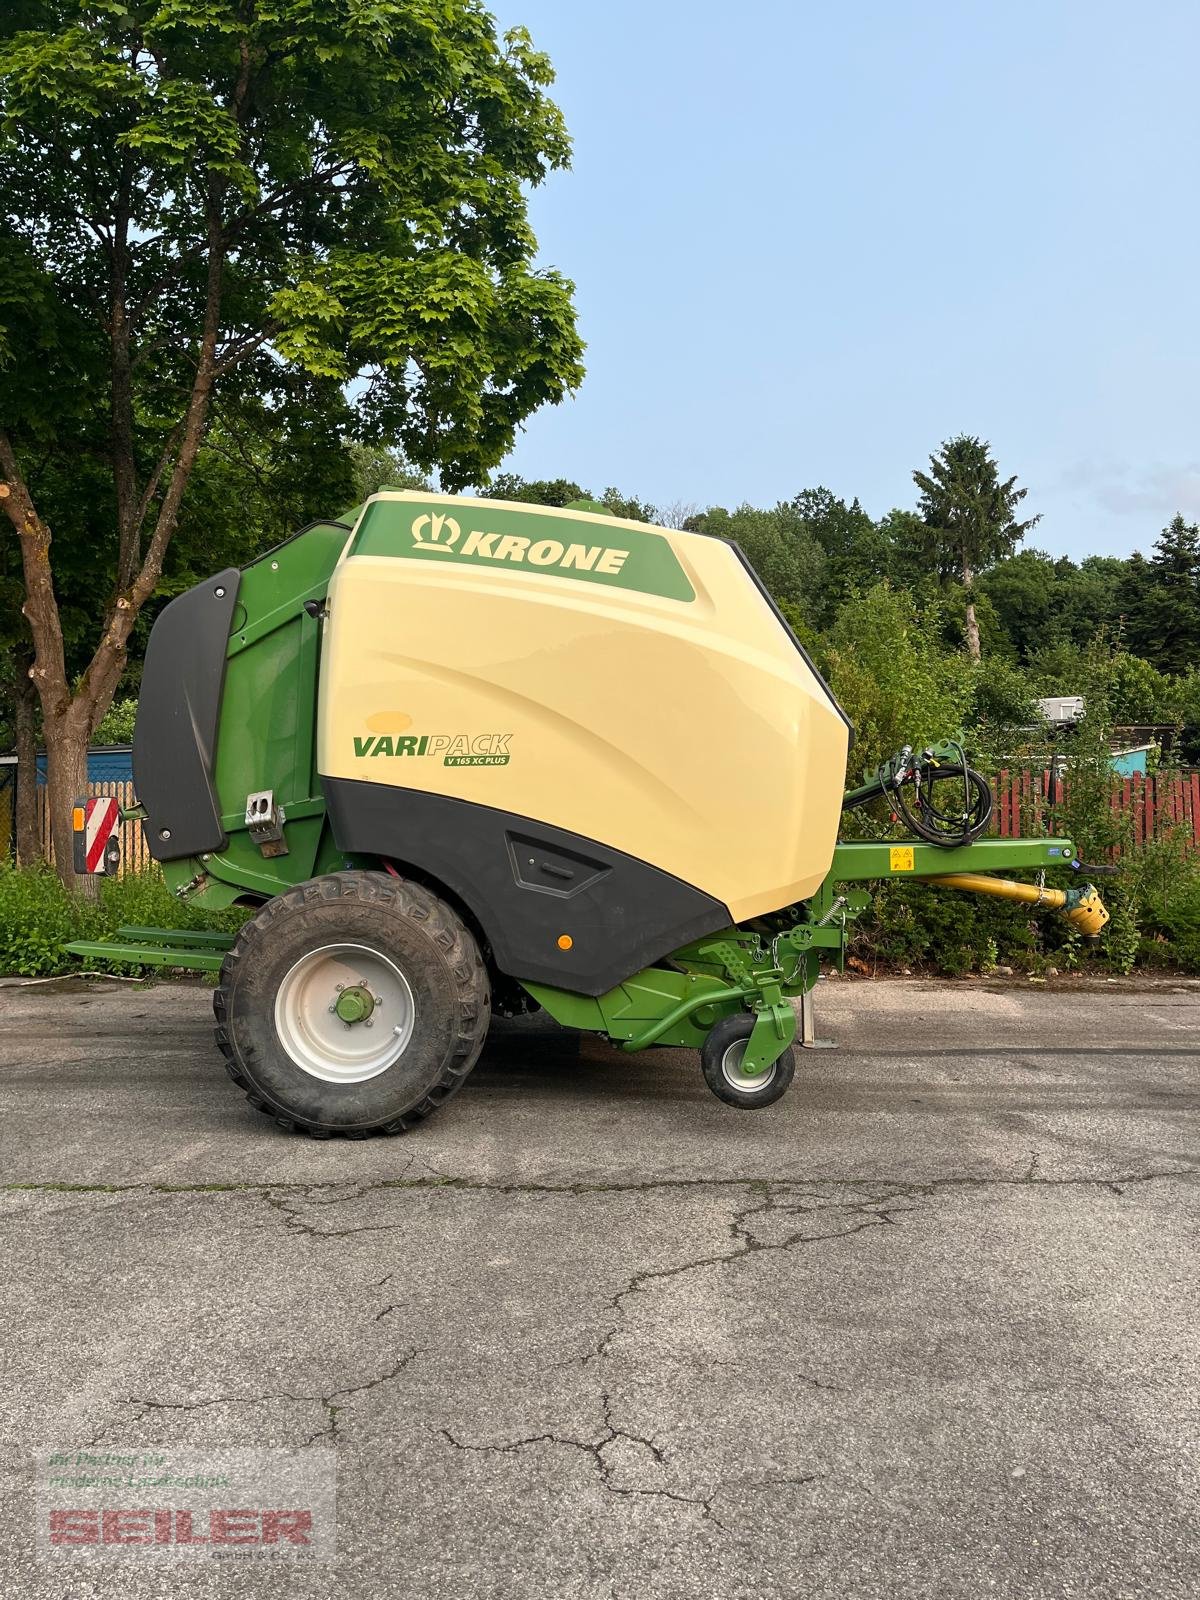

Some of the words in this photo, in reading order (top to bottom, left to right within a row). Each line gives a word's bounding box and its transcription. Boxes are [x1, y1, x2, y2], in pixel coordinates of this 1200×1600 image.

[459, 530, 630, 575] KRONE
[353, 734, 514, 757] VARIPACK
[472, 757, 485, 765] XC
[485, 756, 506, 764] PLUS
